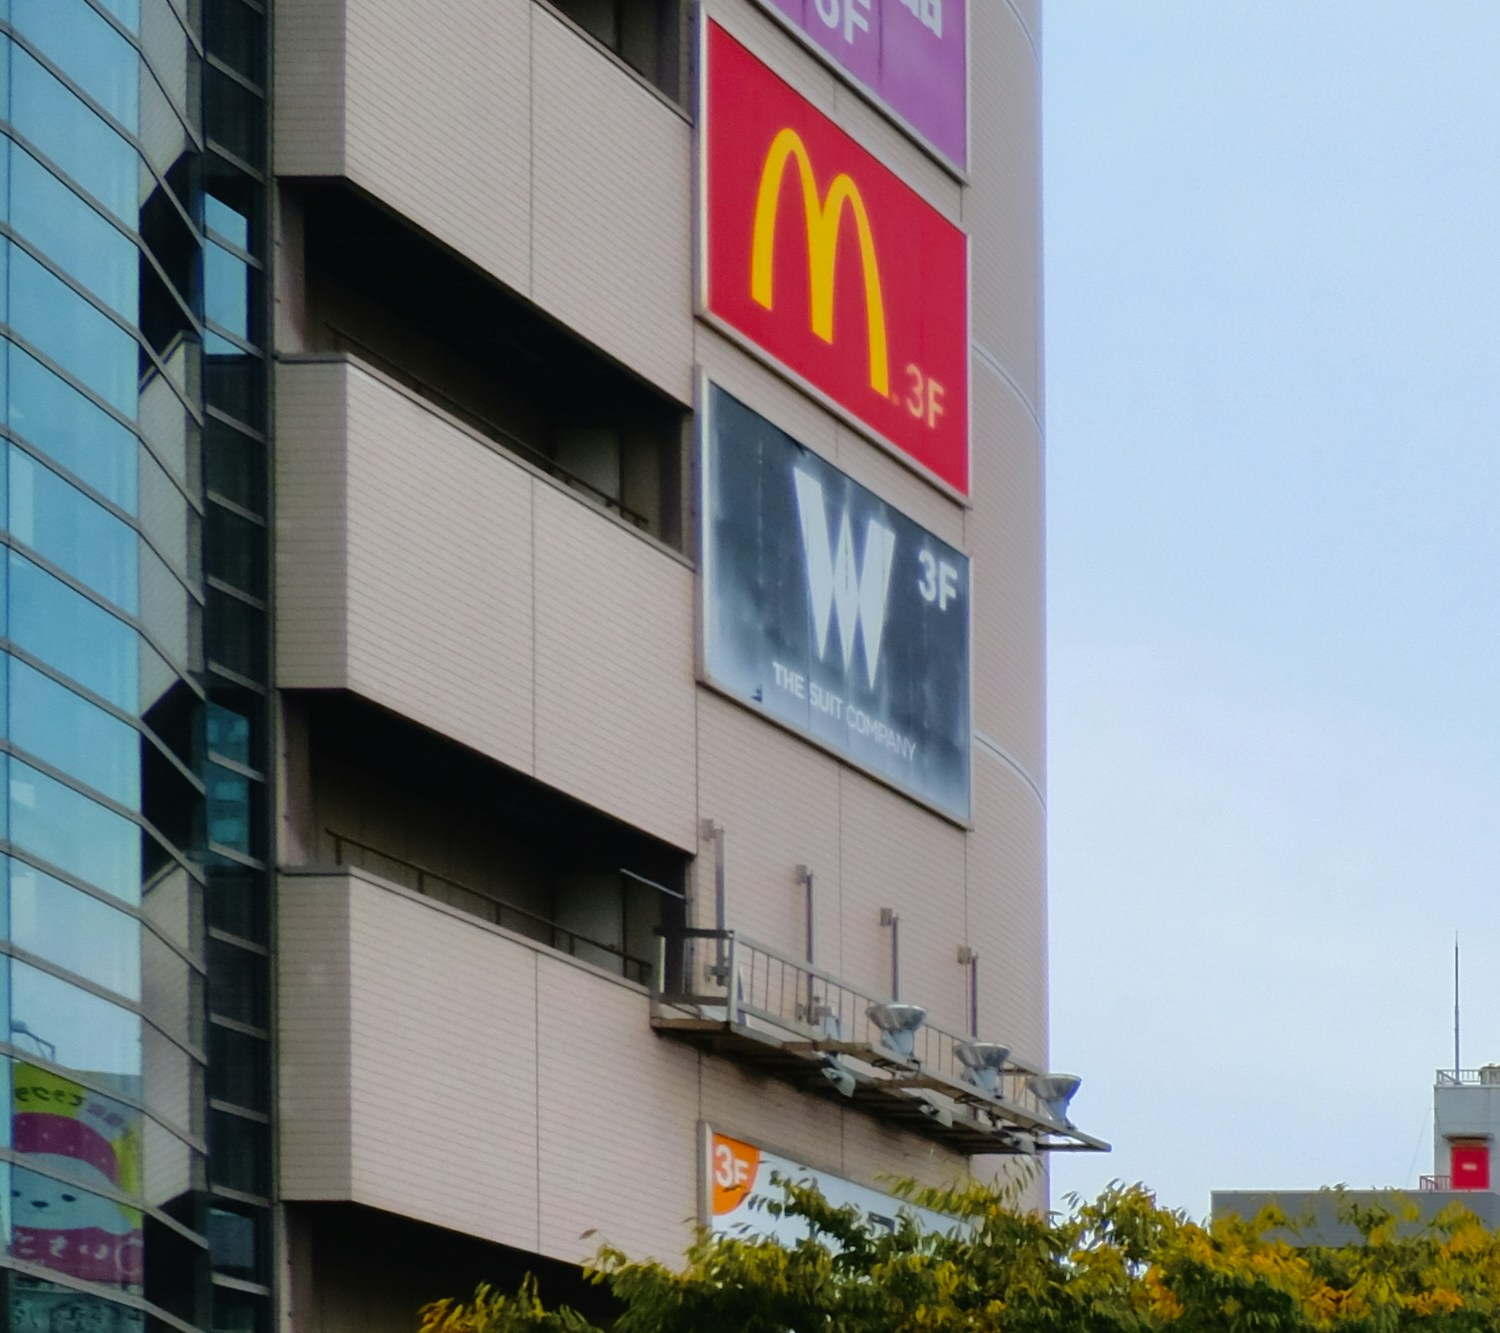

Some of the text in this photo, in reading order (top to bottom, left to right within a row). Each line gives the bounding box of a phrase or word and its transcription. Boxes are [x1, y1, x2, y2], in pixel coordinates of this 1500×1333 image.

[906, 364, 945, 430] 3F
[918, 549, 958, 612] 3F
[772, 661, 917, 763] THE SUIT COMPANY
[715, 1144, 749, 1189] 3F
